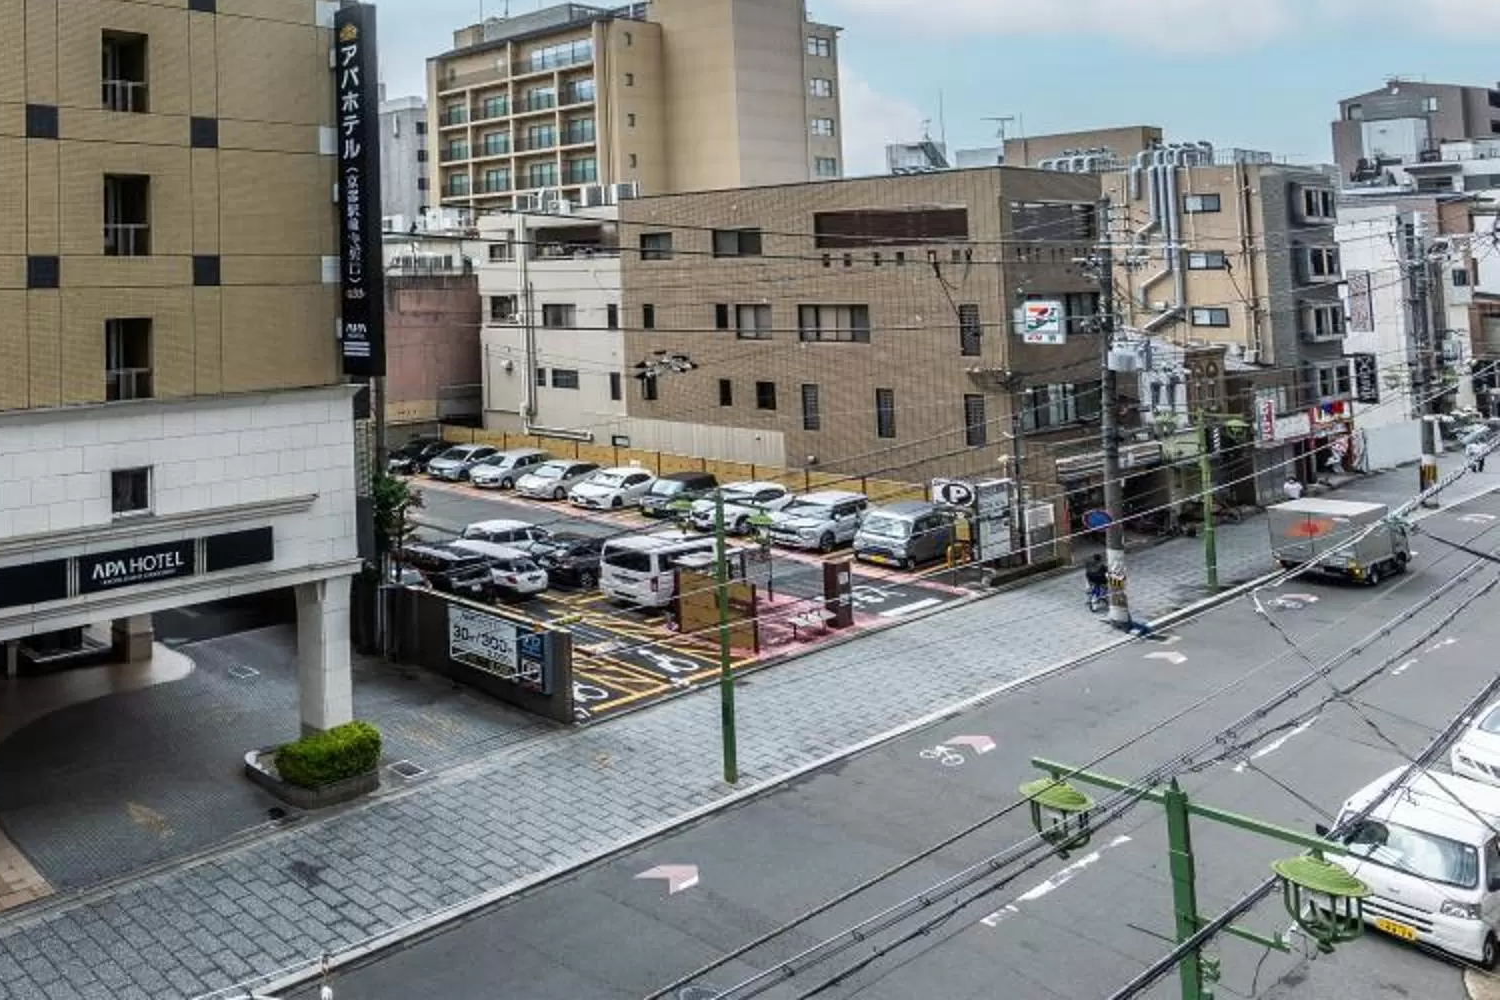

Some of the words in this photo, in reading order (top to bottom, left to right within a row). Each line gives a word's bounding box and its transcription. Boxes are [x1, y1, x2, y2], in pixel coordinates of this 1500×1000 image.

[340, 44, 361, 160] アパホテル
[91, 560, 127, 580] APA
[129, 551, 185, 573] HOTEL
